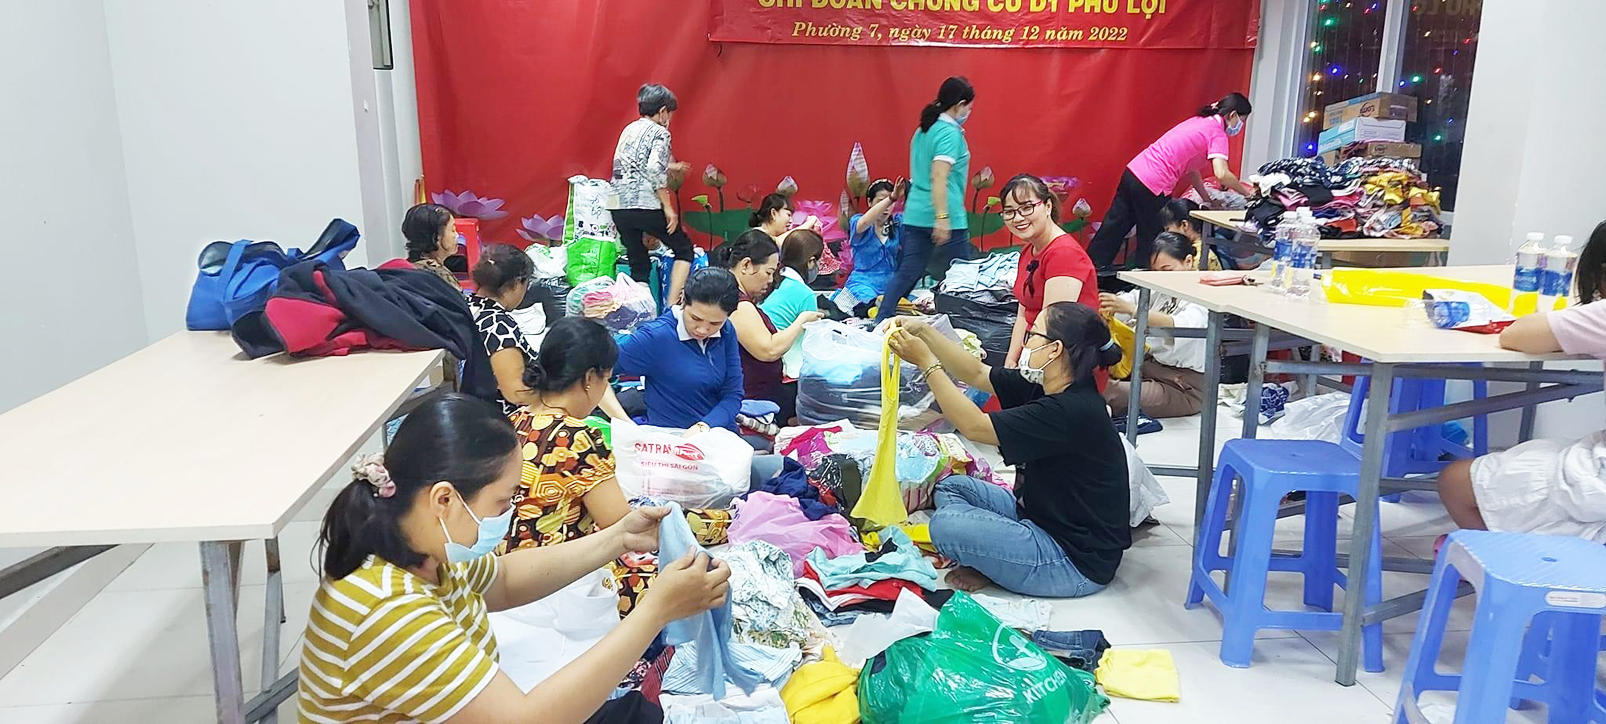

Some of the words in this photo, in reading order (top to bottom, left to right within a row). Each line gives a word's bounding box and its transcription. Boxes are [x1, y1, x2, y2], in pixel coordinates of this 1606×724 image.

[792, 21, 863, 41] Phường
[868, 23, 882, 40] 7,
[888, 24, 931, 42] ngày
[937, 25, 958, 39] 17
[962, 25, 1015, 43] tháng
[1020, 26, 1040, 40] 12
[1045, 26, 1084, 41] năm
[1088, 26, 1128, 41] 2022
